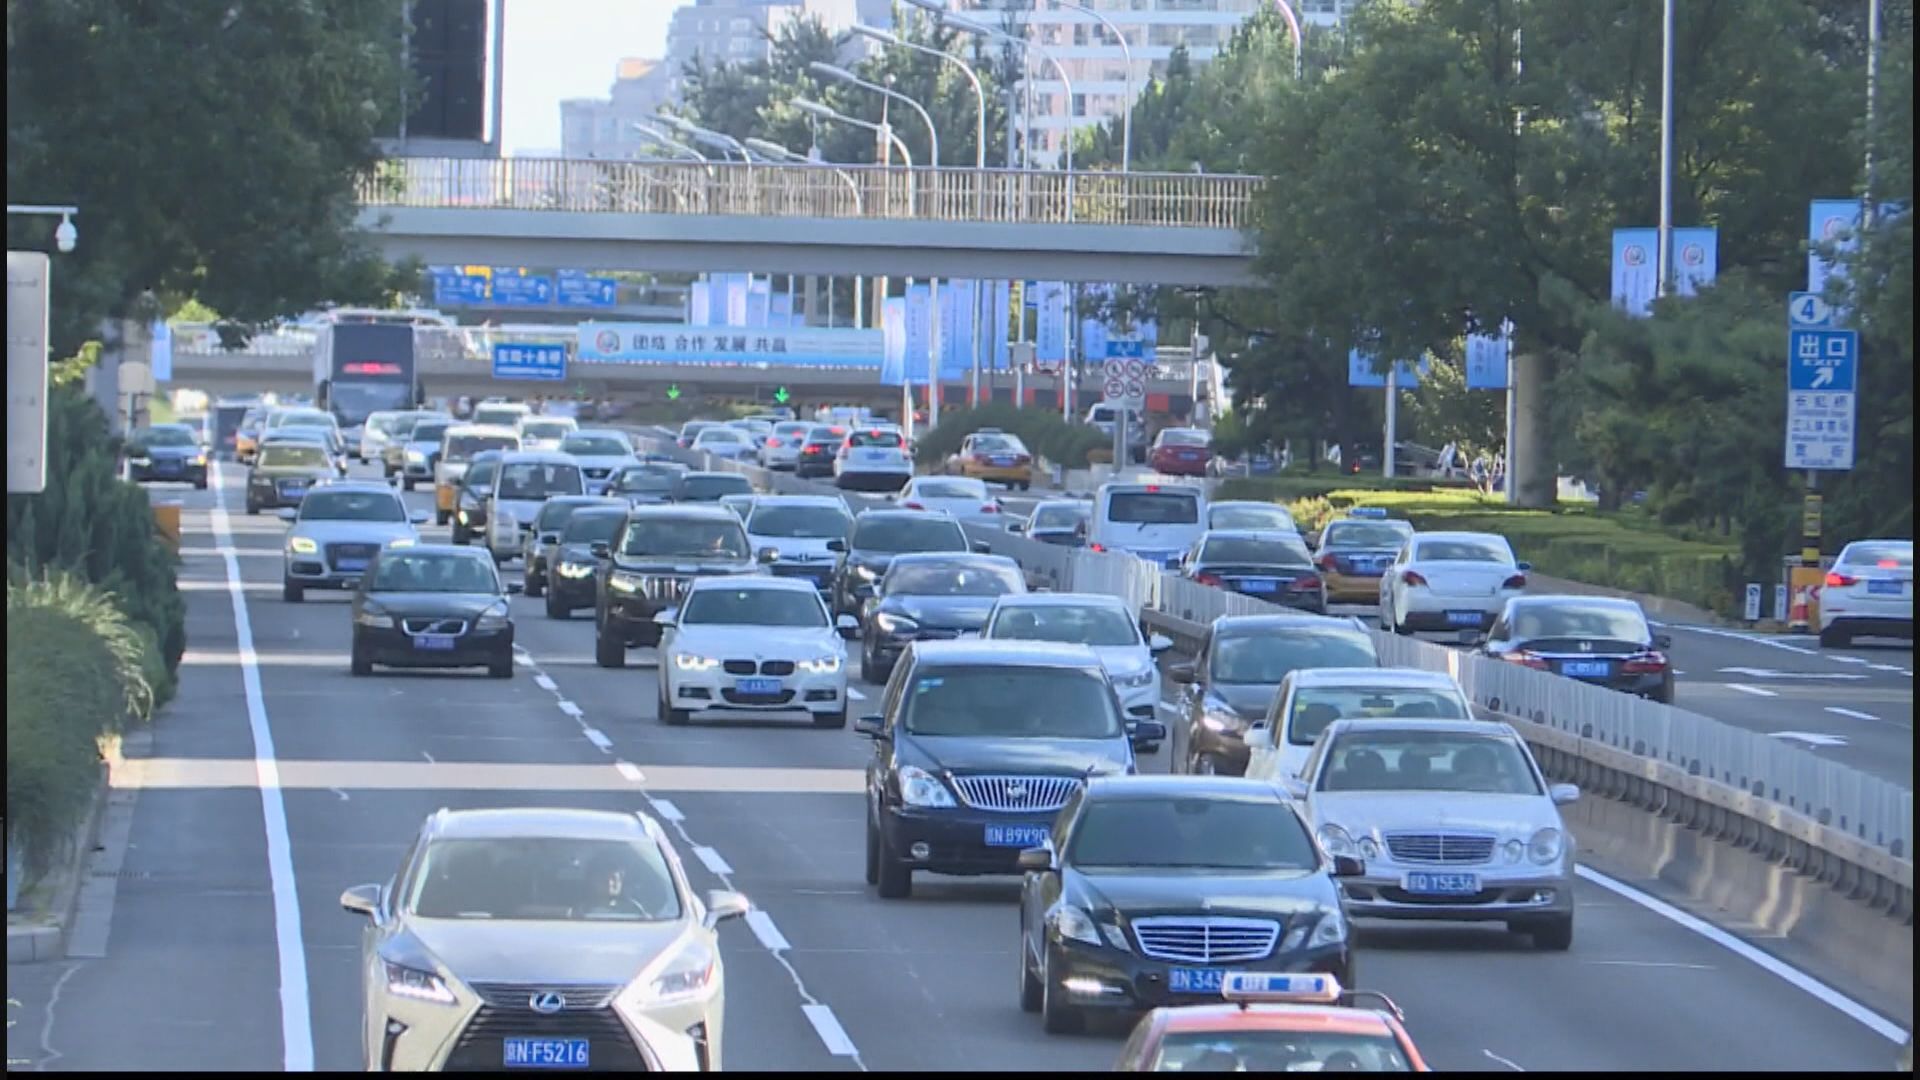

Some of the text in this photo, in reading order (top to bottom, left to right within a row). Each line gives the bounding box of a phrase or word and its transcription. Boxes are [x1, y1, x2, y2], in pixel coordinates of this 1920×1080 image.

[1801, 299, 1814, 320] 4
[675, 334, 707, 352] 合作
[714, 334, 746, 352] 发展
[1799, 334, 1848, 359] 出口
